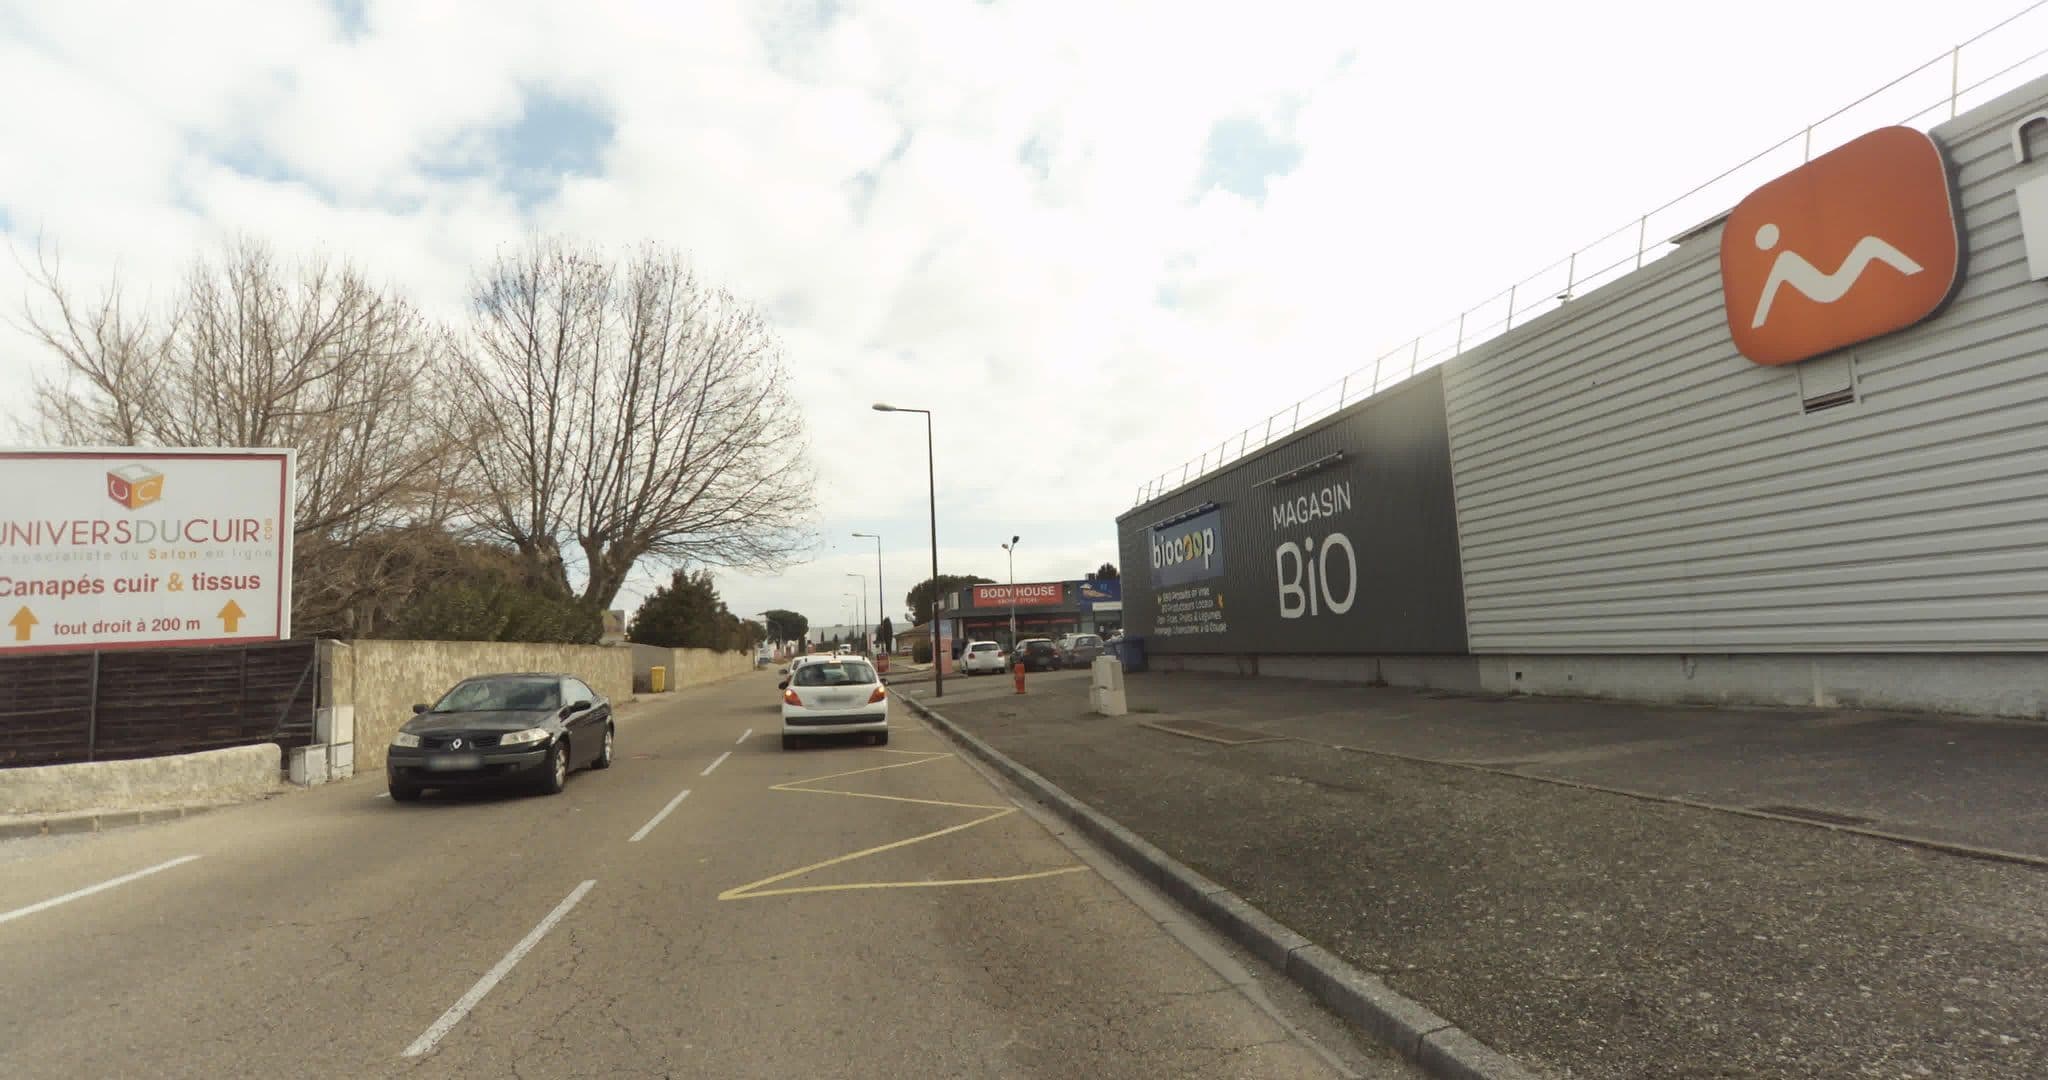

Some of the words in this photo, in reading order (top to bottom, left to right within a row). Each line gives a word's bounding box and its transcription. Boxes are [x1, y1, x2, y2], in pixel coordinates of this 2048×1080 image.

[1272, 483, 1352, 531] MAGASIN
[120, 549, 139, 561] du
[147, 548, 198, 561] Salon
[1152, 527, 1215, 570] biocoop
[113, 575, 159, 593] cuir
[167, 572, 184, 592] &
[192, 572, 261, 592] tissus
[980, 588, 1012, 598] BODY
[1016, 586, 1056, 596] HOUSE
[53, 620, 87, 635] tout
[92, 617, 132, 634] droit
[136, 617, 146, 632] à
[151, 617, 181, 632] 200
[186, 619, 201, 631] m
